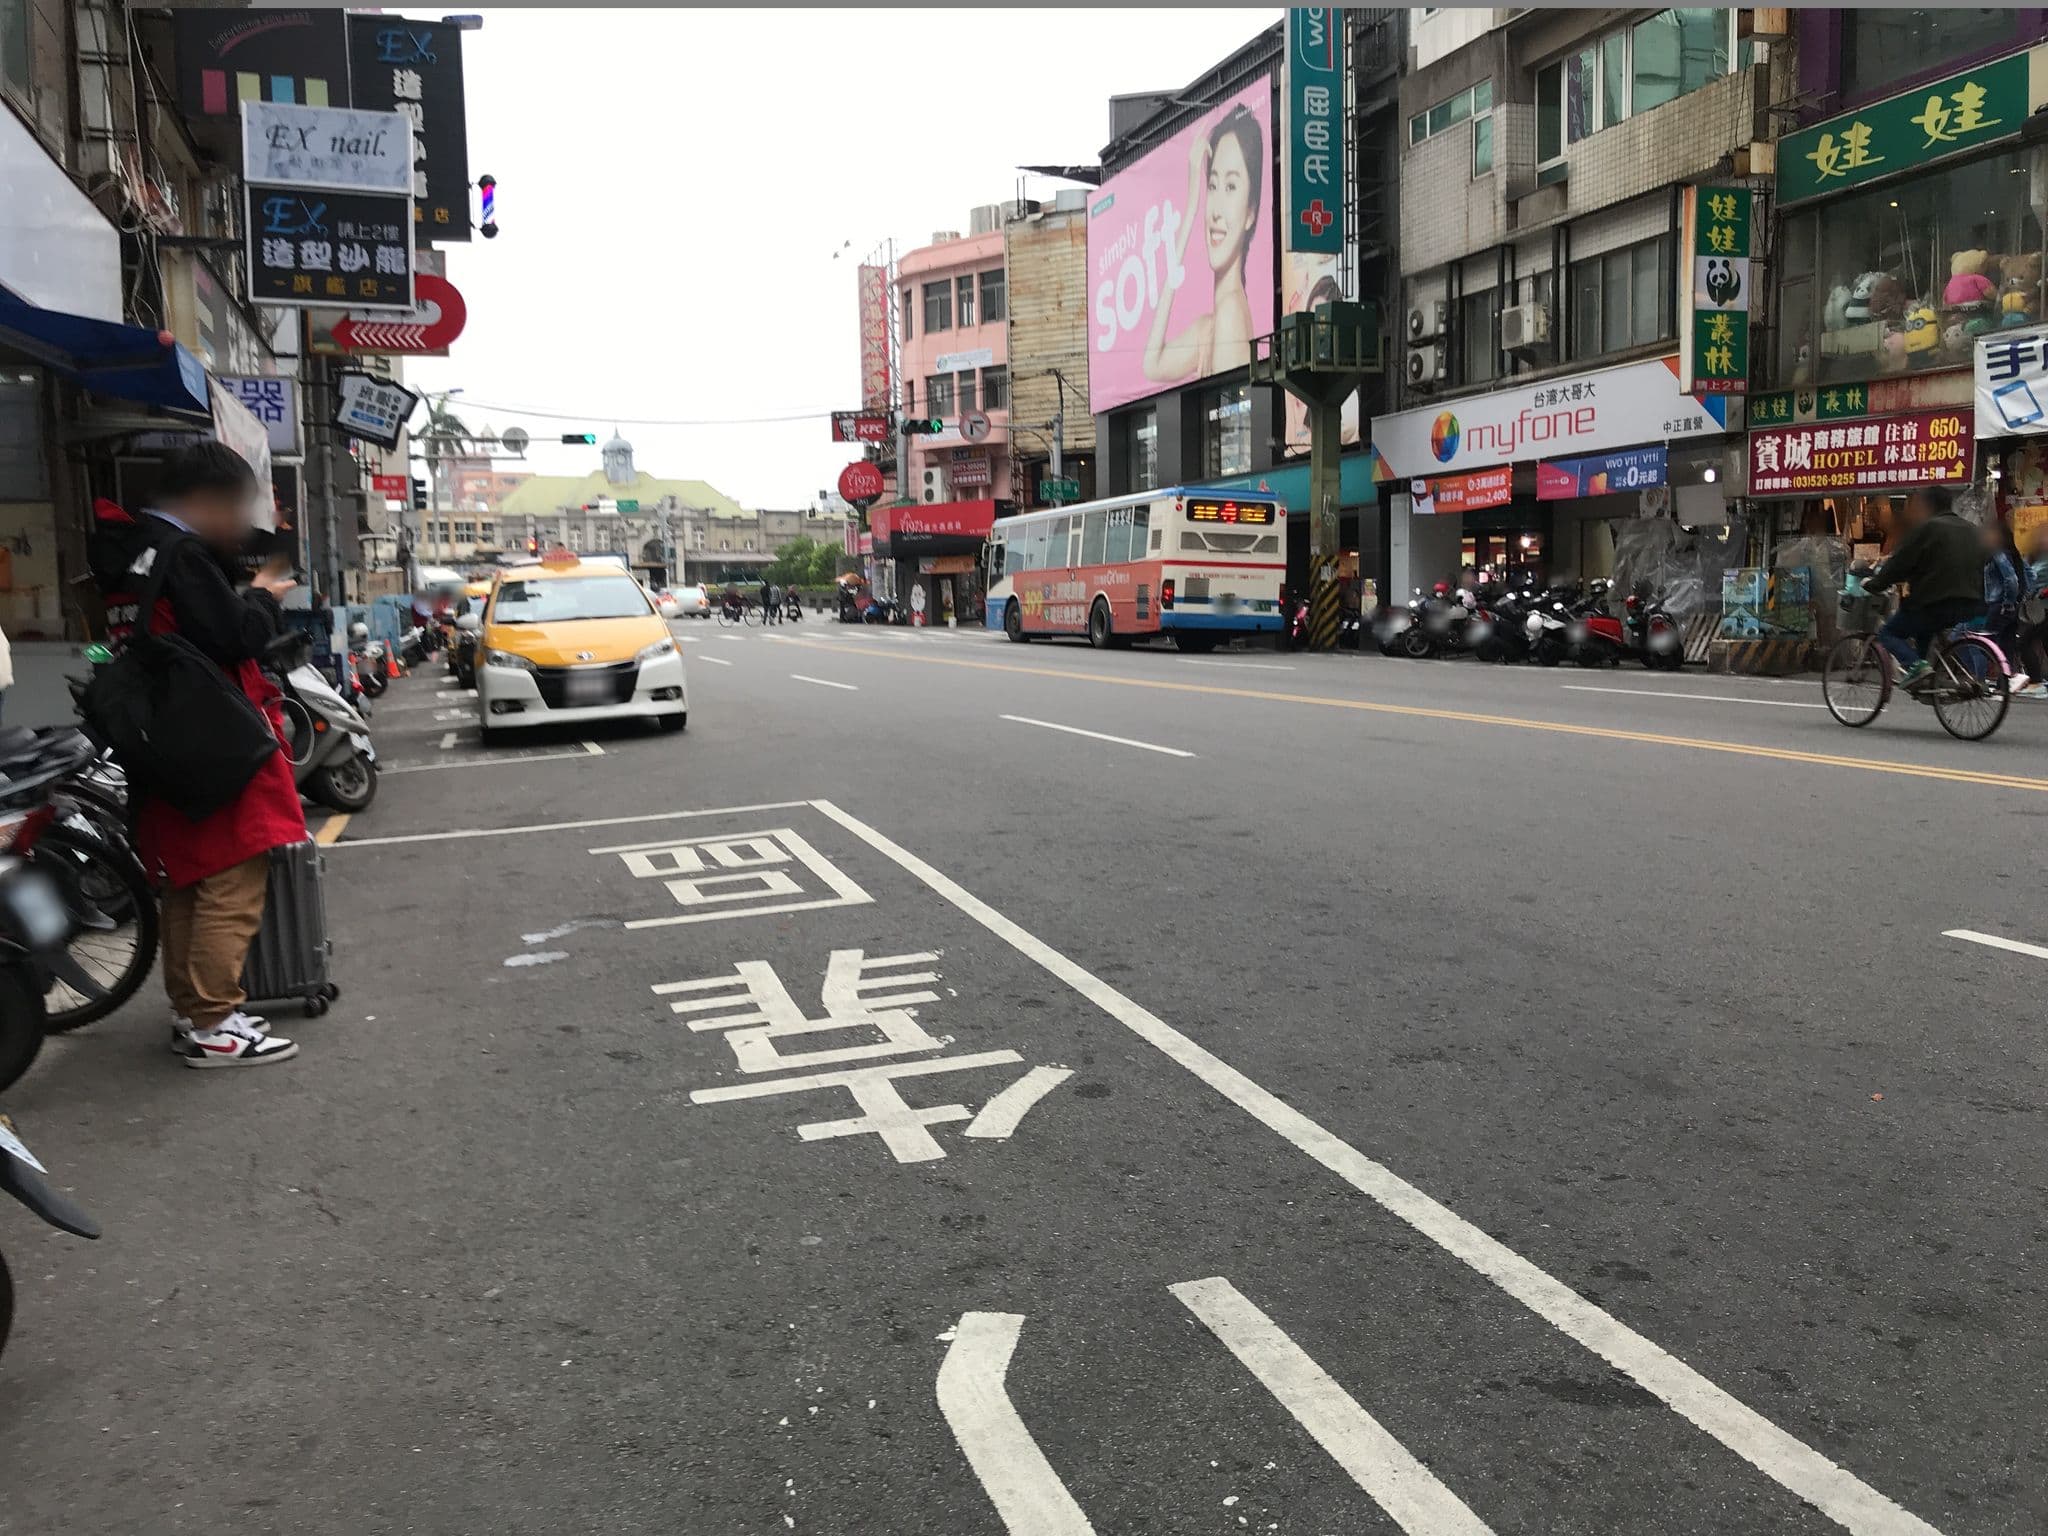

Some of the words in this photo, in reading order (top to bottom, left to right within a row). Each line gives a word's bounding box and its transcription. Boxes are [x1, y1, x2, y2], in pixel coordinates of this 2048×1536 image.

[265, 123, 317, 152] EX
[1303, 85, 1331, 185] 屈臣氏
[1805, 81, 2003, 184] 娃娃
[1706, 193, 1742, 253] 娃娃
[262, 237, 407, 275] 造型沙龍
[1099, 222, 1138, 276] simply
[1095, 198, 1186, 353] soft
[1704, 313, 1739, 375] 叢林
[1985, 335, 2048, 382] 手
[219, 377, 285, 423] 器
[1533, 380, 1597, 409] 台灣大哥大
[1695, 379, 1746, 392] 請上2樓
[858, 423, 884, 435] KFC
[1466, 405, 1596, 456] myfone
[1813, 424, 1881, 451] 商務旅館
[1885, 421, 1919, 443] 住宿
[1813, 449, 1878, 470] HOTEL
[1884, 443, 1917, 465] 休息
